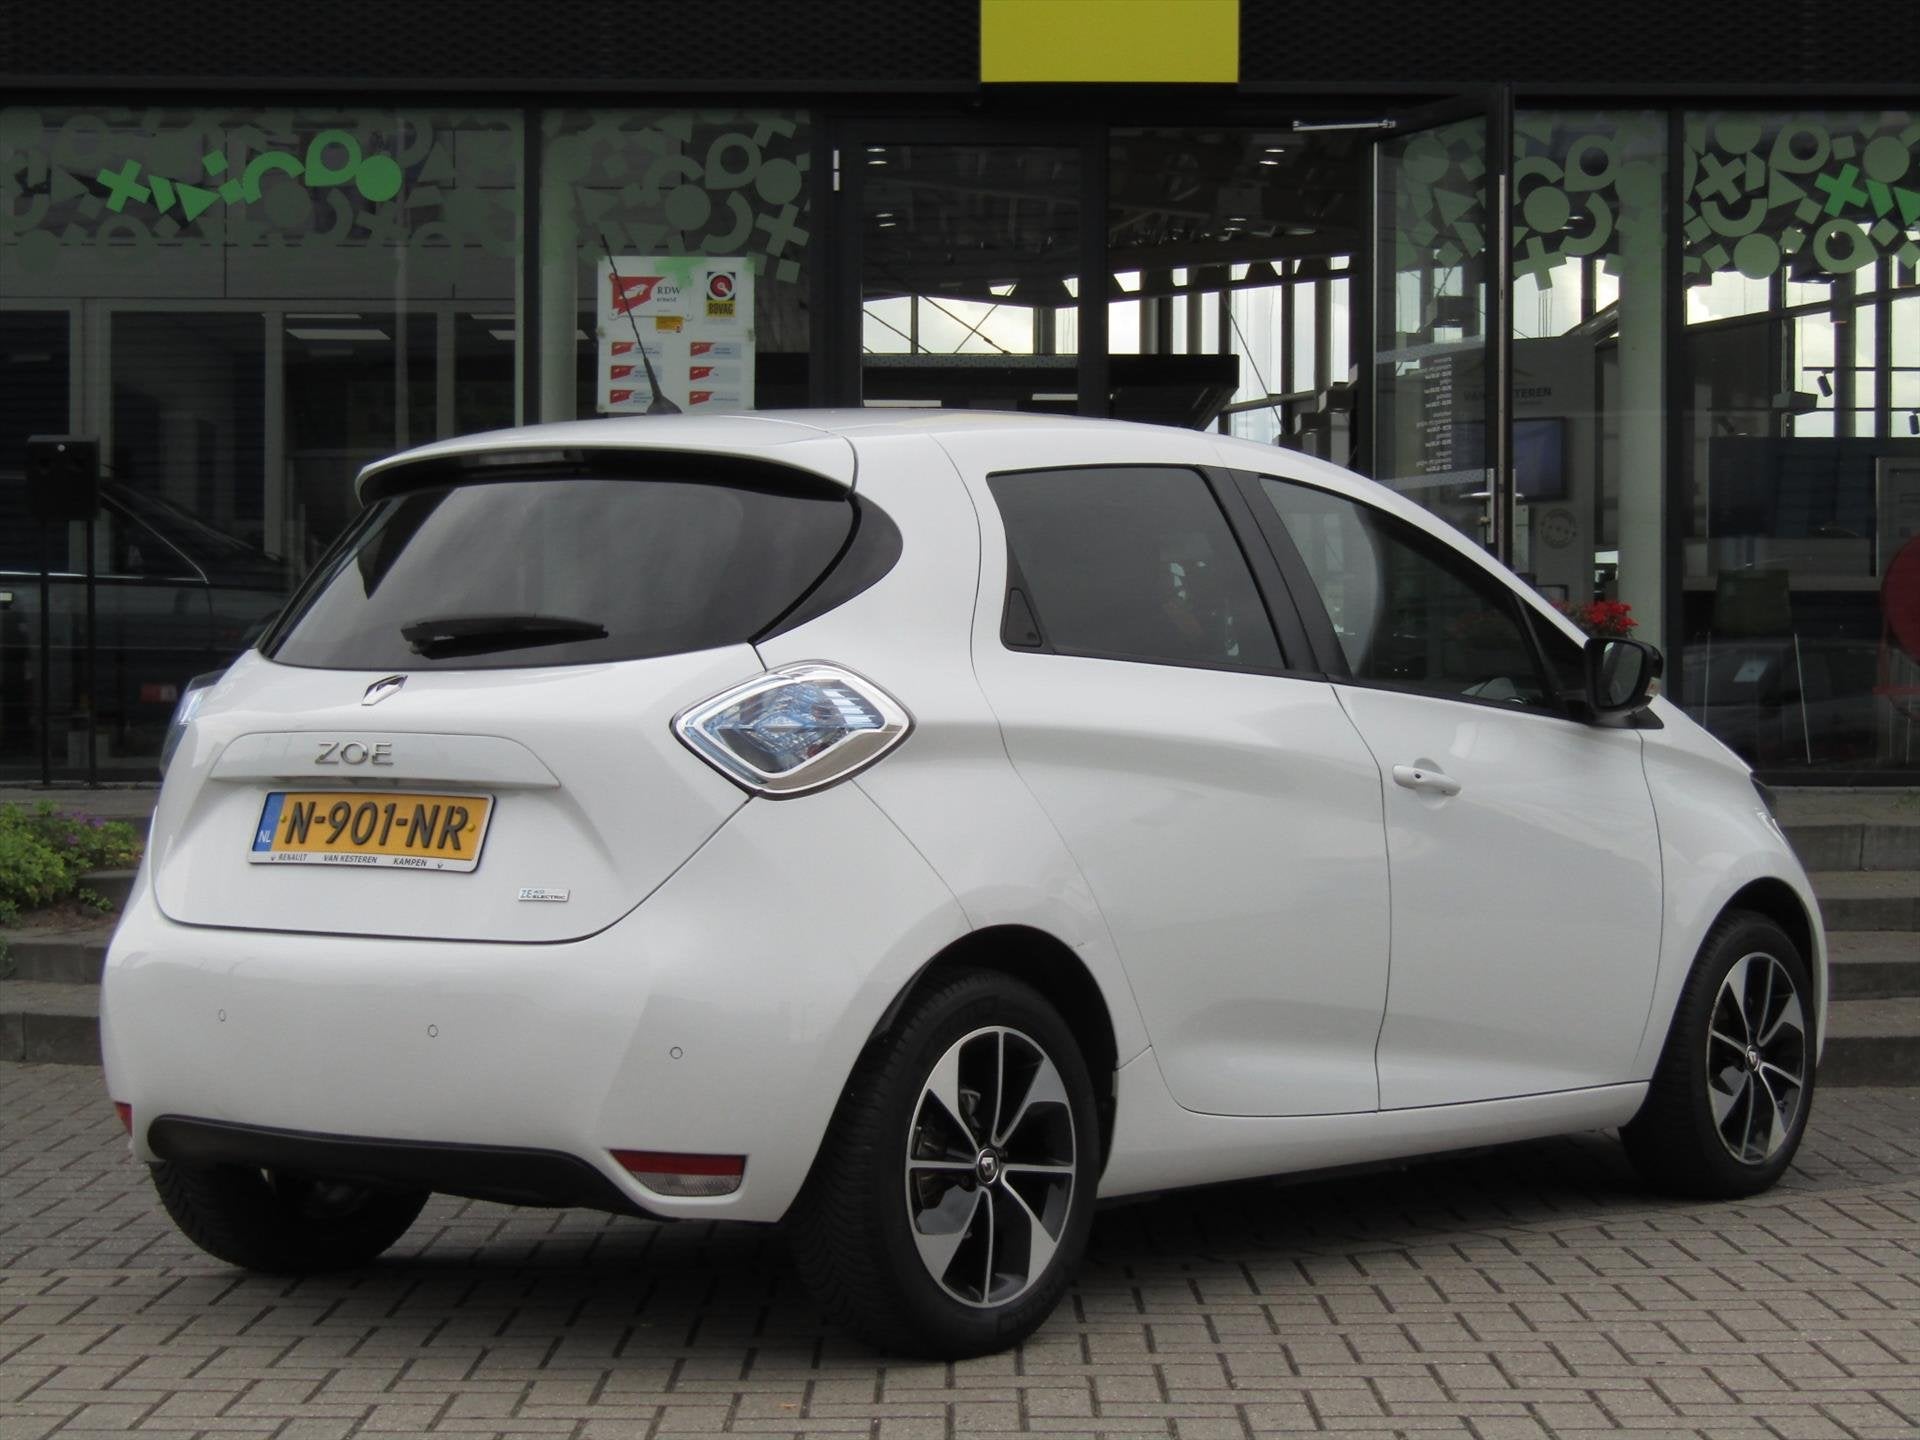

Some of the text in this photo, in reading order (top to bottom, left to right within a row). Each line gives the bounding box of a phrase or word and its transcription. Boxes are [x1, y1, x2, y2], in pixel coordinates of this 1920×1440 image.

[657, 286, 681, 295] RDW
[709, 303, 734, 314] BOVAG
[1512, 387, 1552, 399] TEREN
[315, 740, 394, 766] ZOE
[284, 801, 469, 851] N-901-NR
[257, 829, 272, 844] NL
[278, 853, 428, 867] RENAULT VAN KESTEREN KAMPEN
